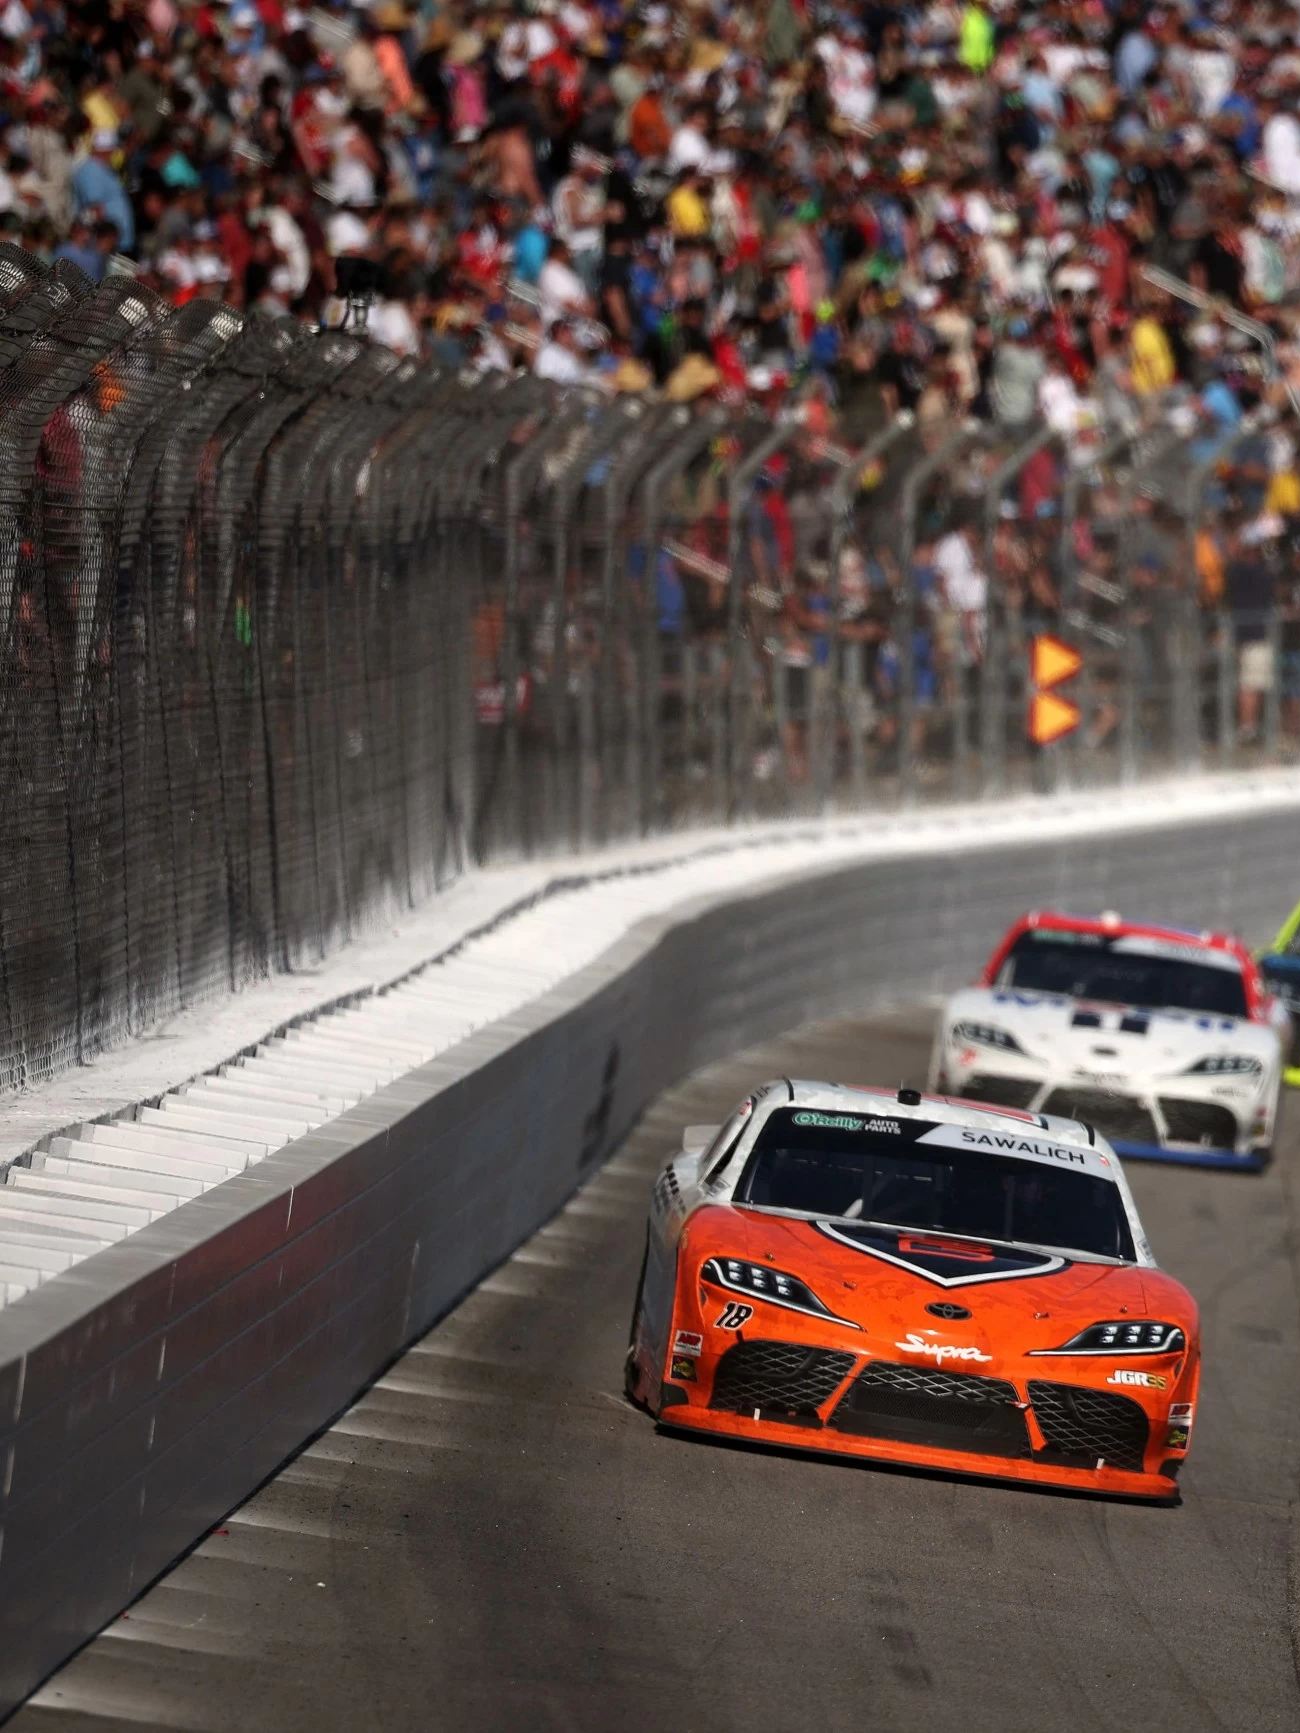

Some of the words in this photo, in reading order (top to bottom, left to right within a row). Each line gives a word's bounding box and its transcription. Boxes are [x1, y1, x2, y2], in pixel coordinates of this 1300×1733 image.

[792, 1111, 862, 1131] O'Reilly
[865, 1123, 901, 1135] PARTS
[869, 1119, 899, 1128] AUTO
[962, 1131, 1085, 1165] SAWALICH
[713, 1301, 754, 1331] 18
[895, 1333, 993, 1366] Supra
